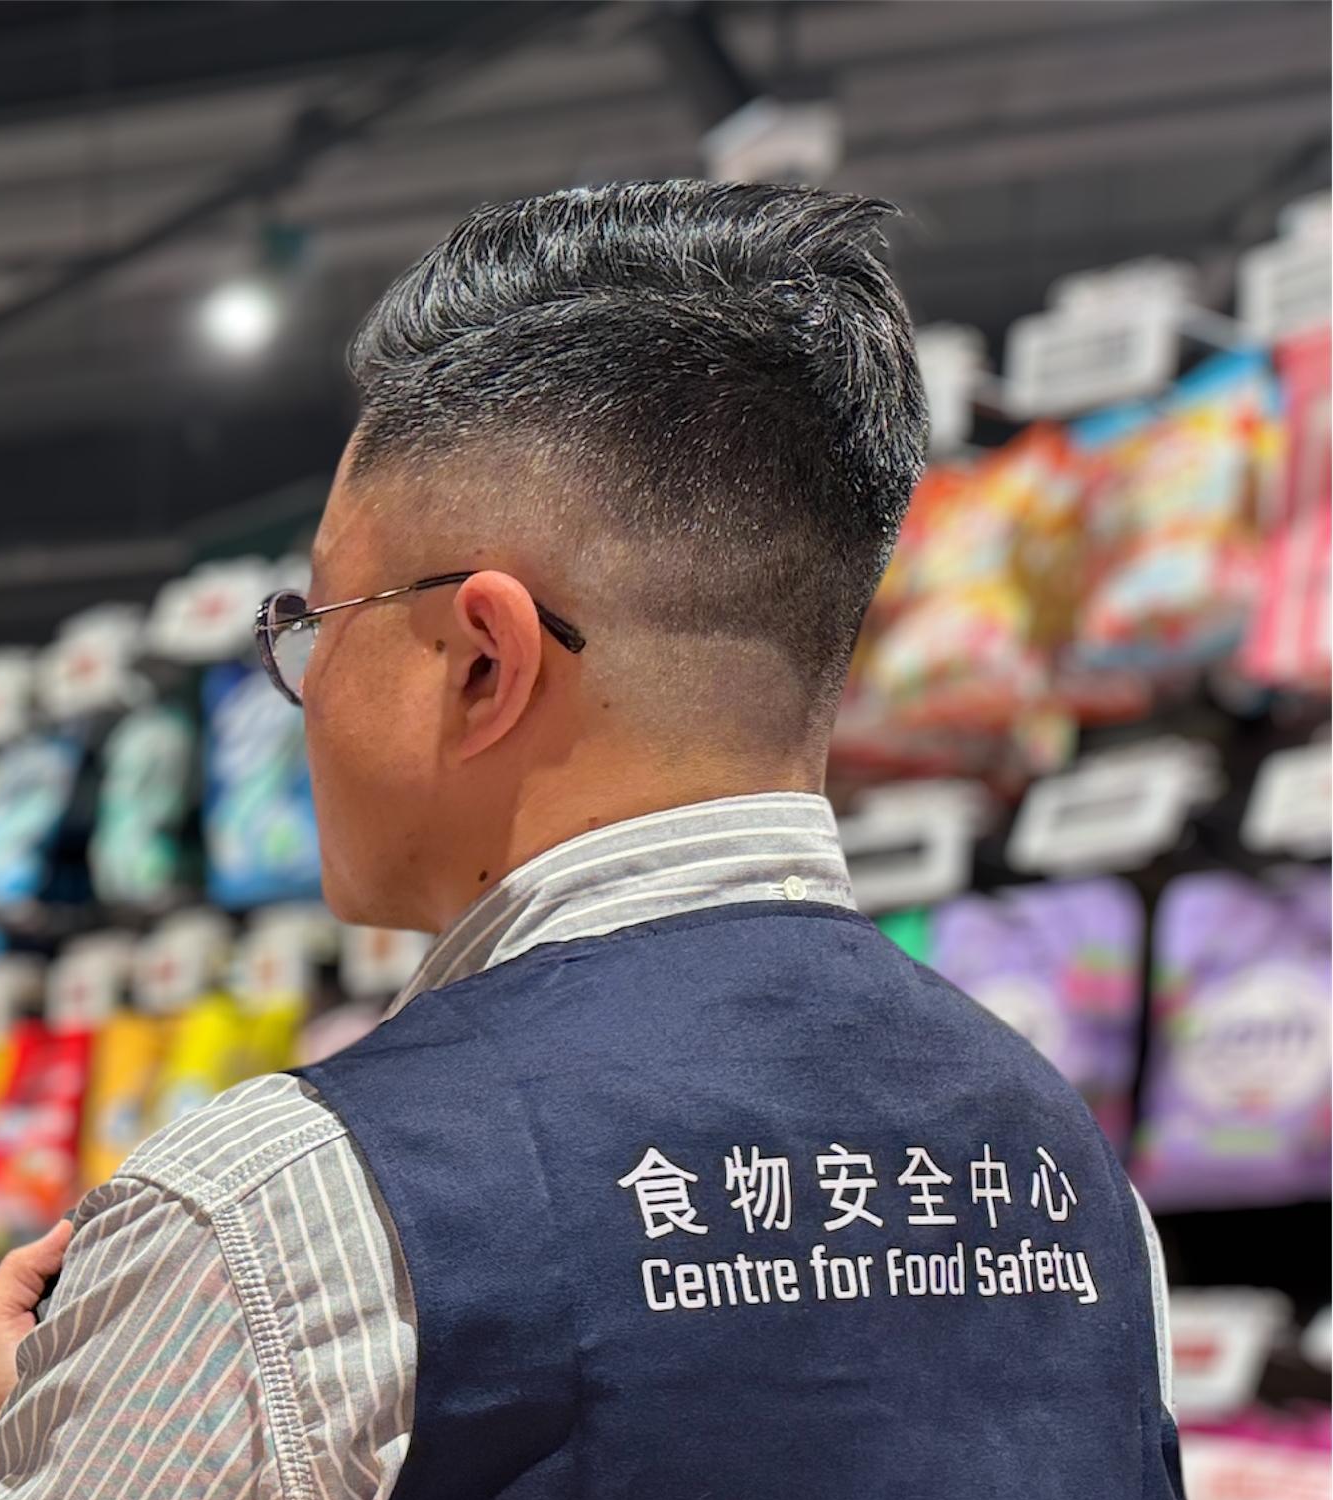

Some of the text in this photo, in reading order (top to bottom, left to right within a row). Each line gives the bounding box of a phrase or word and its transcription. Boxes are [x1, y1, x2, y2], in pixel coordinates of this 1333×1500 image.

[617, 1143, 1078, 1240] 食物安全中心
[641, 1238, 1099, 1312] Centre for Food Safety
